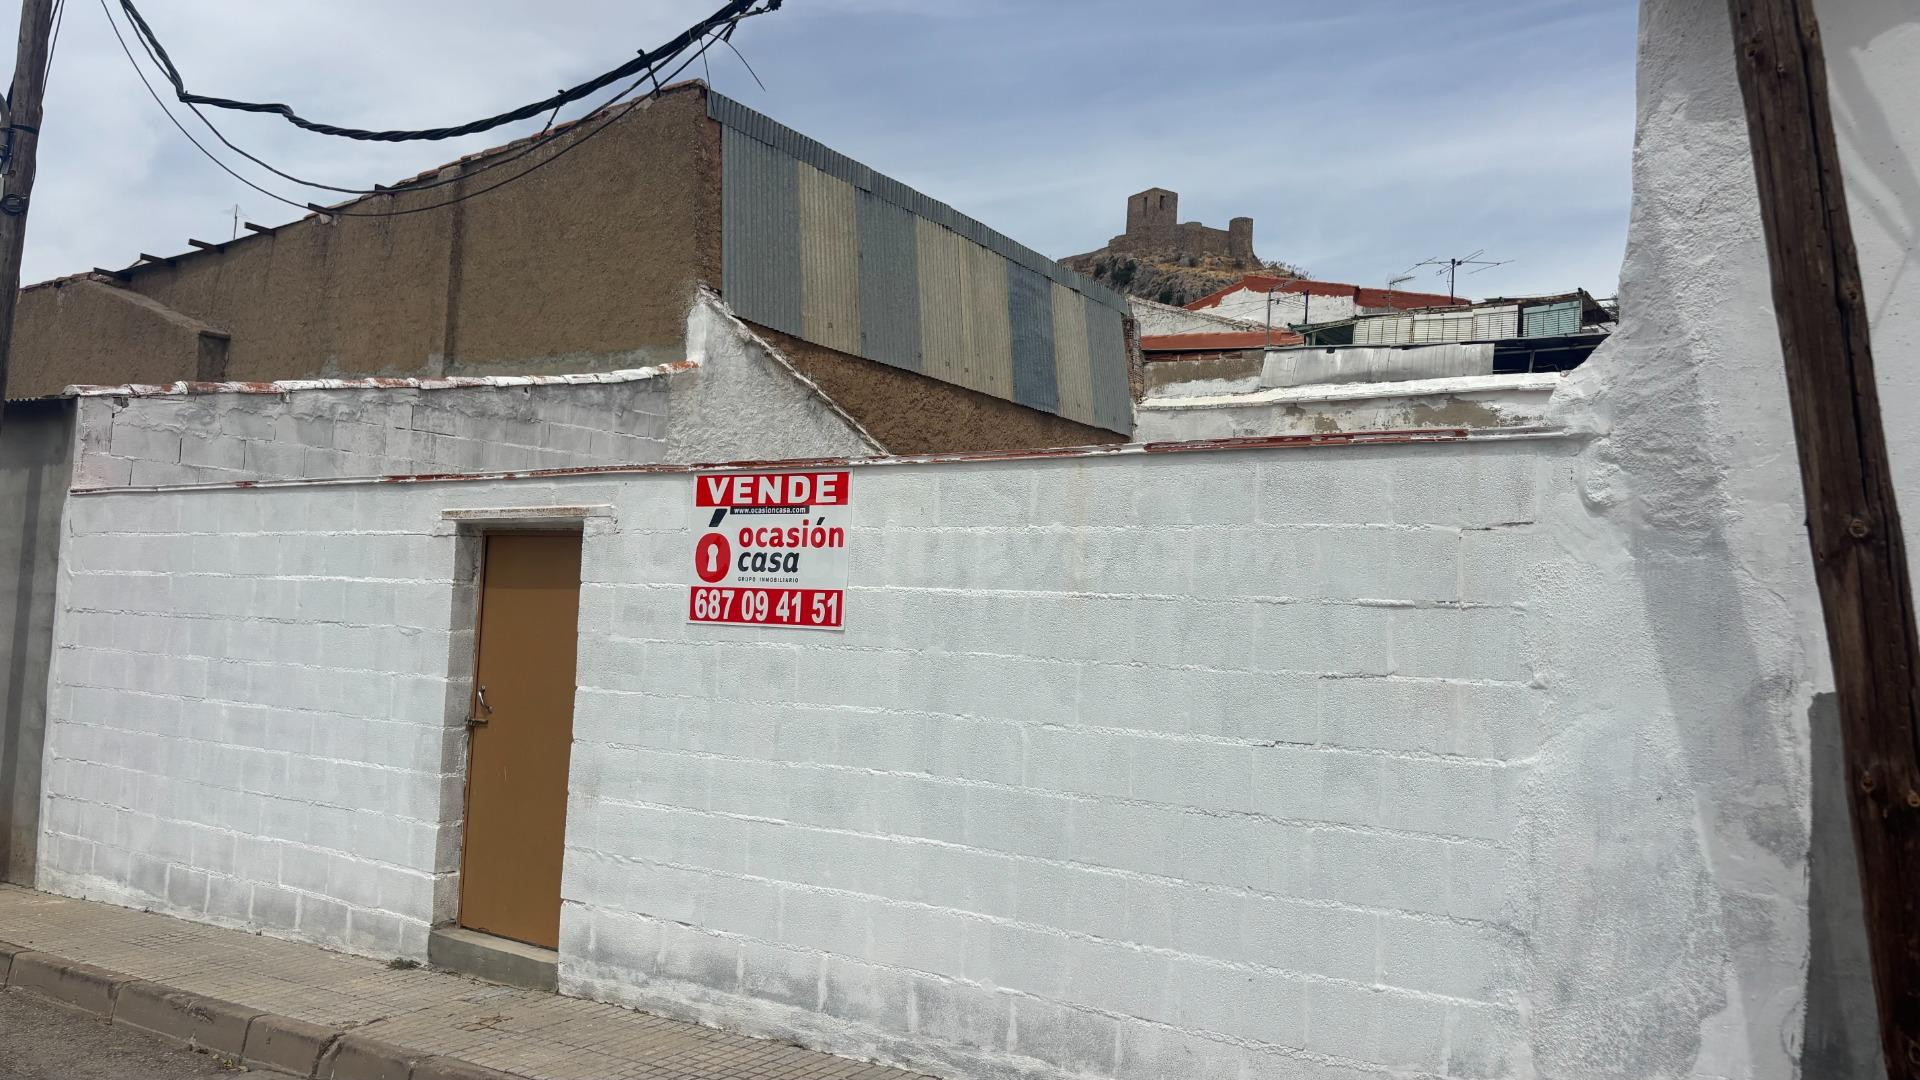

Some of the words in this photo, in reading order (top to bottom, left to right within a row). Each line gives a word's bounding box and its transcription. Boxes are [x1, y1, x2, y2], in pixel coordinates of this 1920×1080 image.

[706, 474, 838, 505] VENDE
[738, 517, 845, 548] ocasión
[737, 551, 800, 573] casa
[694, 588, 736, 620] 687
[741, 590, 769, 622] 09
[776, 591, 802, 623] 41
[811, 592, 838, 625] 51
